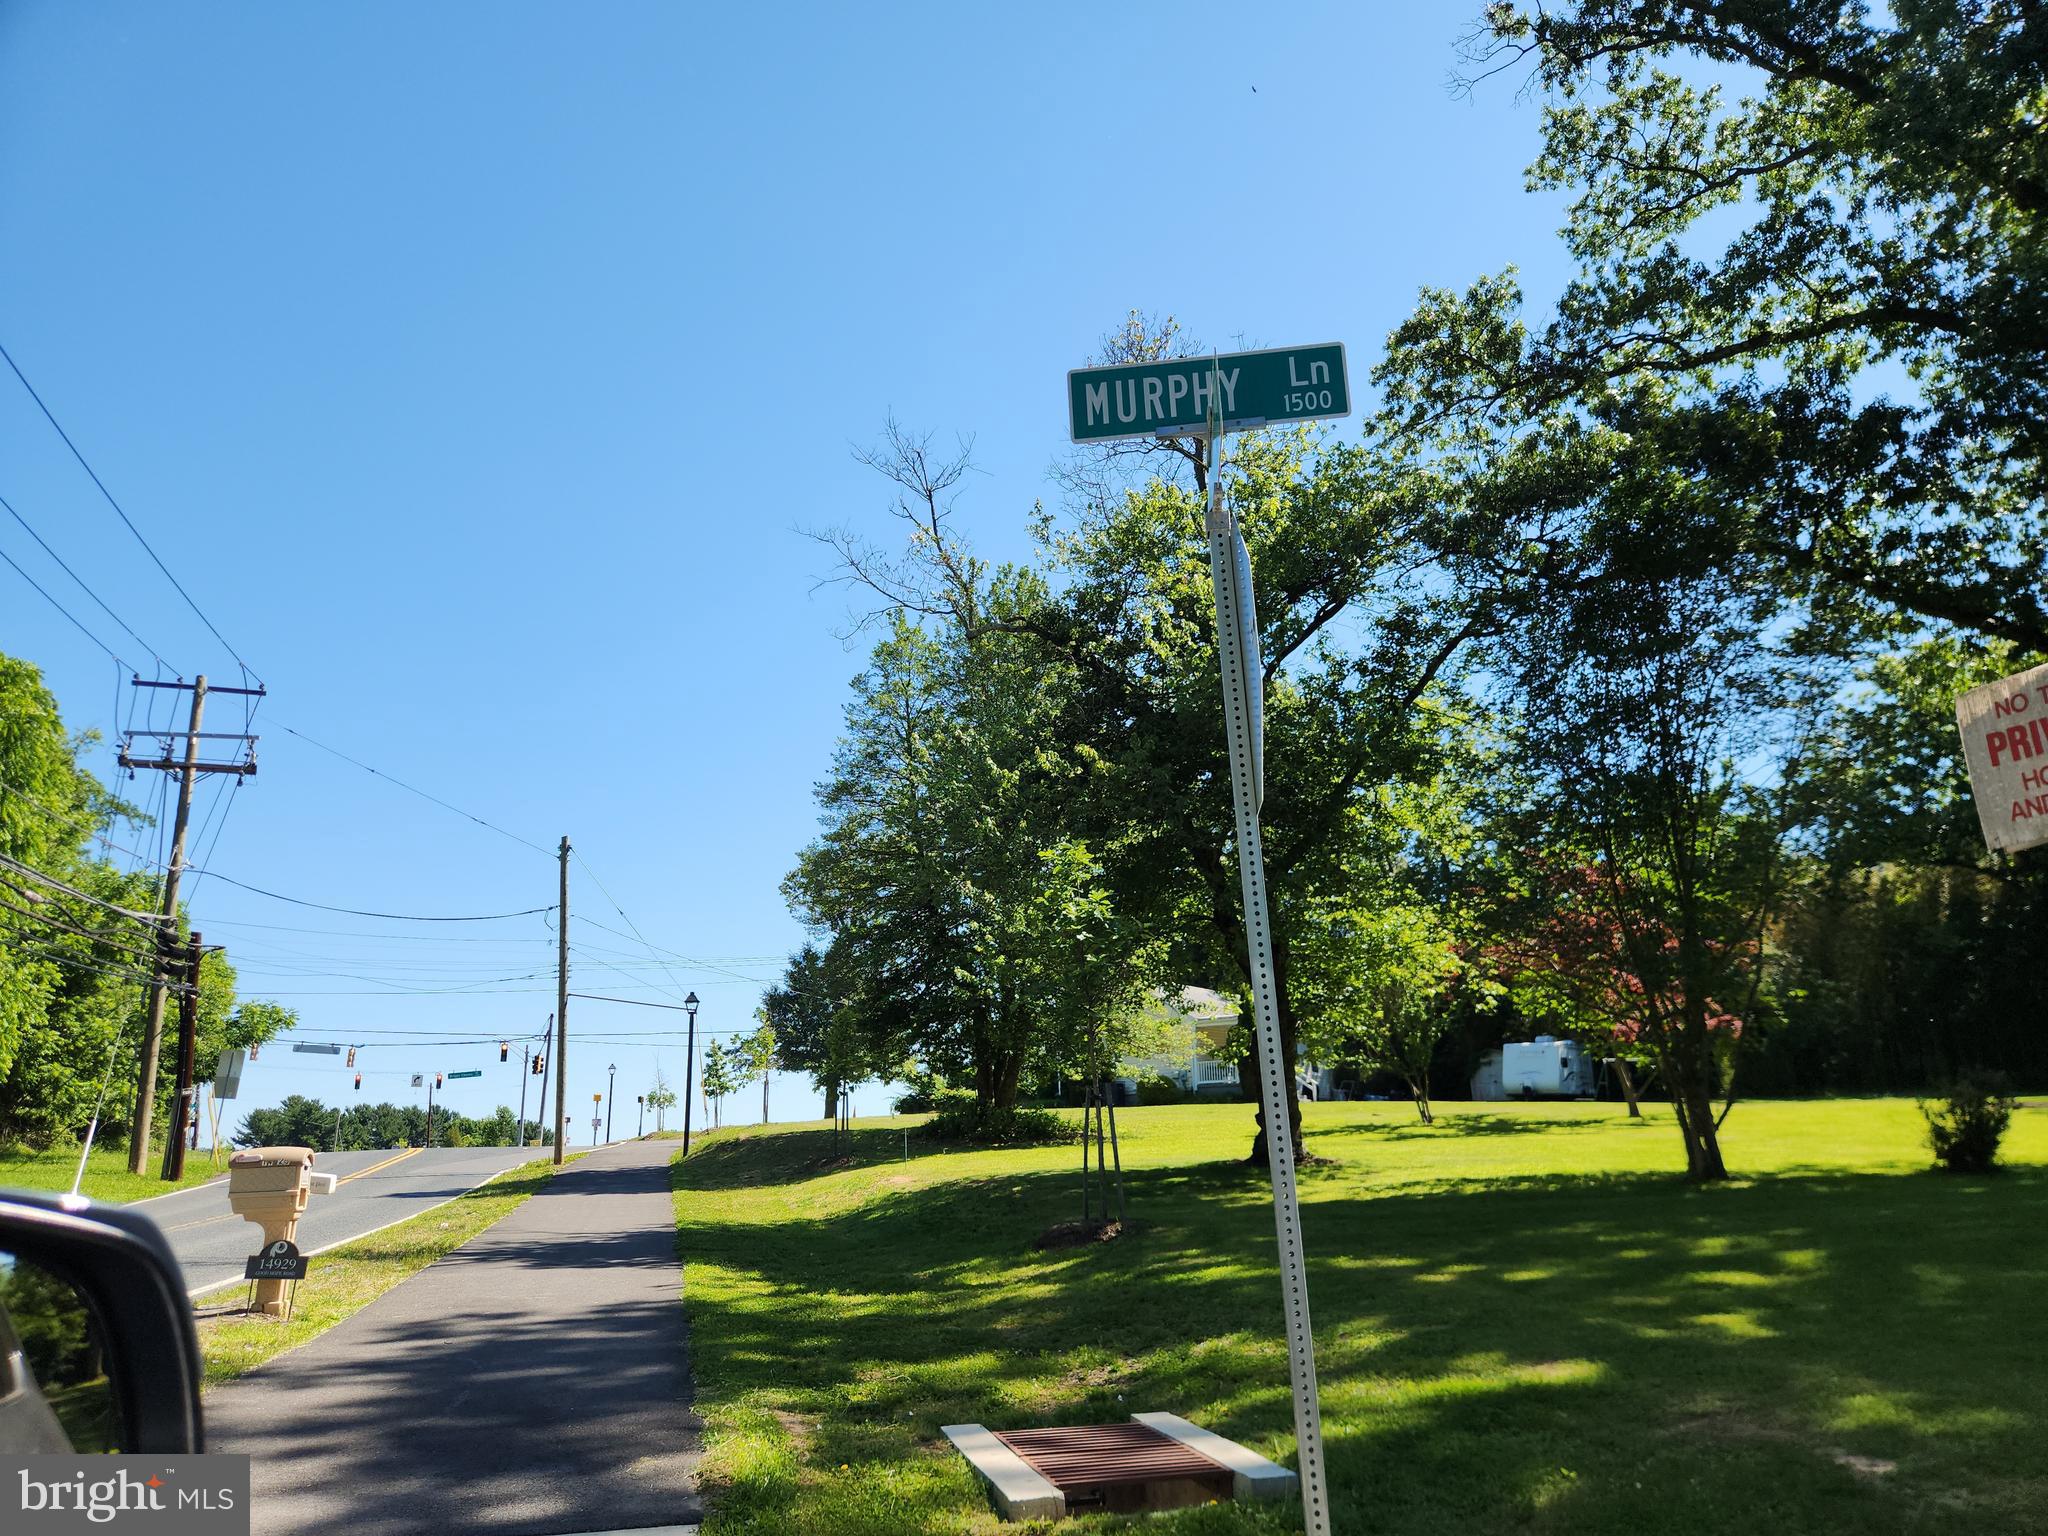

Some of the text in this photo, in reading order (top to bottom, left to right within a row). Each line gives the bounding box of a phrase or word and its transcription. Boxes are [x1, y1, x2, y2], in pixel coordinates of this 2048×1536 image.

[1085, 356, 1330, 426] MURPHY Ln
[1283, 390, 1332, 412] 1500
[1994, 693, 2029, 718] NO
[260, 1258, 297, 1270] 14929
